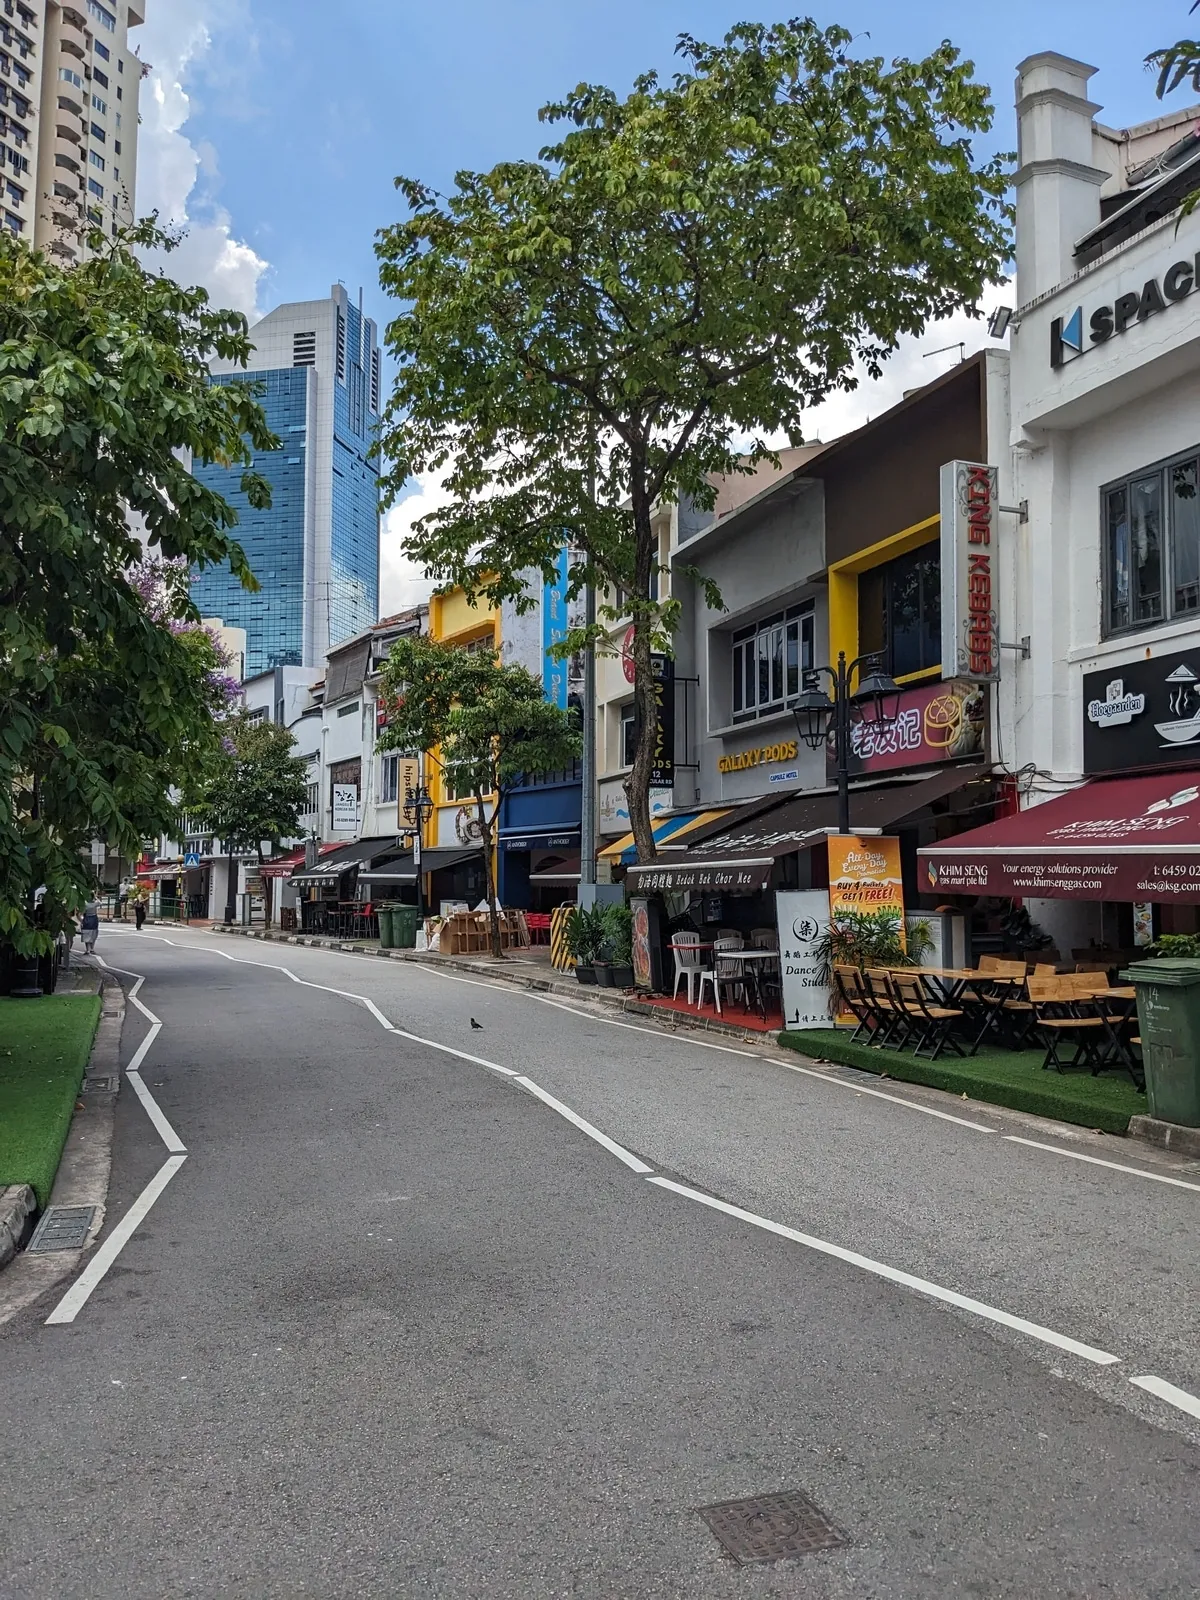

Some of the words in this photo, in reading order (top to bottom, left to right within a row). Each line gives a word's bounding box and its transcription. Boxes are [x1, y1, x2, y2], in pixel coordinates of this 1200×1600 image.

[1089, 251, 1200, 343] SPAC
[968, 466, 990, 544] KING
[968, 553, 992, 674] KEBABS
[1090, 696, 1141, 718] Hoegaarden
[718, 748, 761, 773] GALAXY
[764, 741, 798, 763] PODS
[770, 773, 786, 782] CAPSULE
[786, 771, 798, 779] HOTEL
[856, 868, 886, 878] Promotion
[939, 865, 963, 876] KHIM
[964, 865, 988, 876] SENG
[1002, 863, 1019, 873] Your
[1020, 864, 1047, 876] energy
[1047, 863, 1082, 874] solutions
[1081, 863, 1118, 876] provider
[1153, 865, 1161, 876] t:
[1162, 865, 1187, 876] 6459
[676, 873, 695, 886] Bedok
[698, 873, 711, 885] Bak
[714, 872, 733, 884] Chor
[737, 871, 752, 884] Mee
[939, 877, 950, 887] gas
[950, 876, 966, 885] mart
[966, 876, 977, 887] pte
[978, 876, 988, 886] ltd
[1012, 876, 1102, 890] www.khimsenggas.com
[836, 882, 853, 890] BUY
[853, 881, 860, 890] 4
[842, 892, 856, 901] GET
[858, 891, 864, 901] 1
[865, 888, 894, 901] FREE!
[786, 966, 818, 975] Dance
